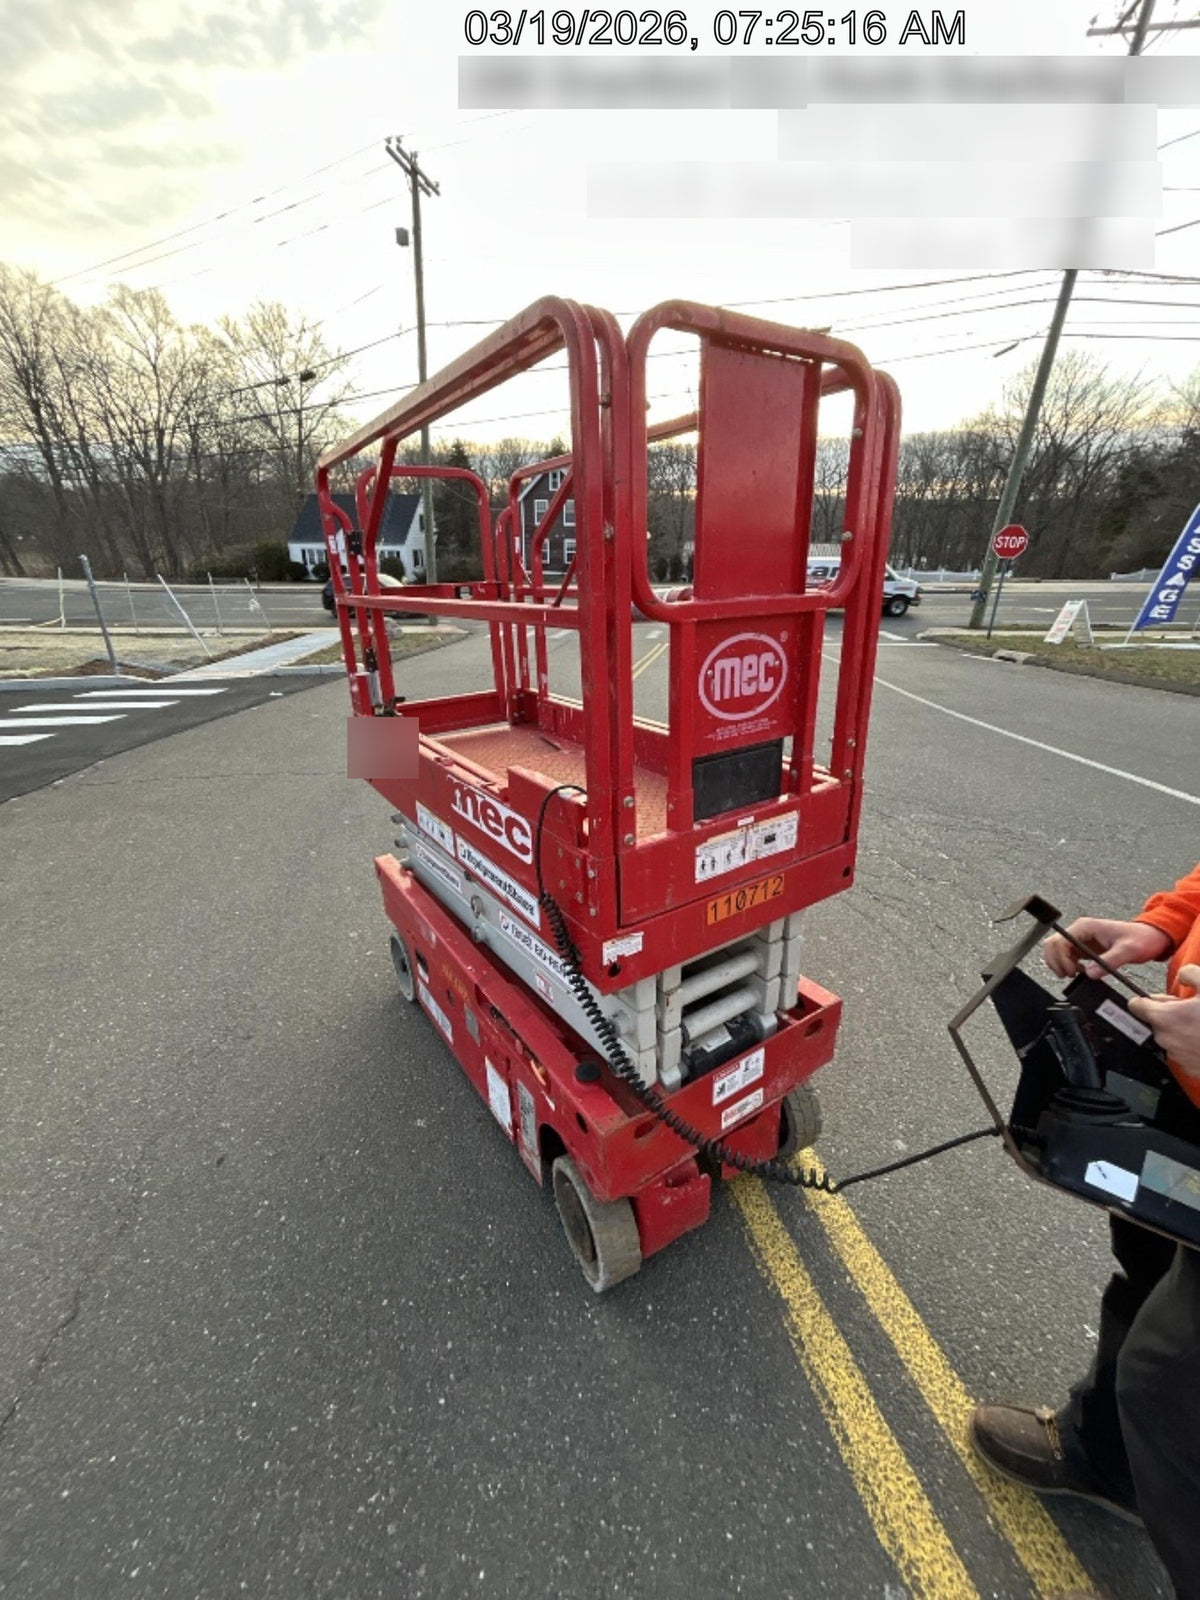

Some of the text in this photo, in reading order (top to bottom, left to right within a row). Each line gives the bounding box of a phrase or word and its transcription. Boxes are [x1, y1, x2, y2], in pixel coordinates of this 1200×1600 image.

[995, 536, 1026, 549] STOP
[713, 652, 776, 701] mec
[710, 875, 783, 921] 110712
